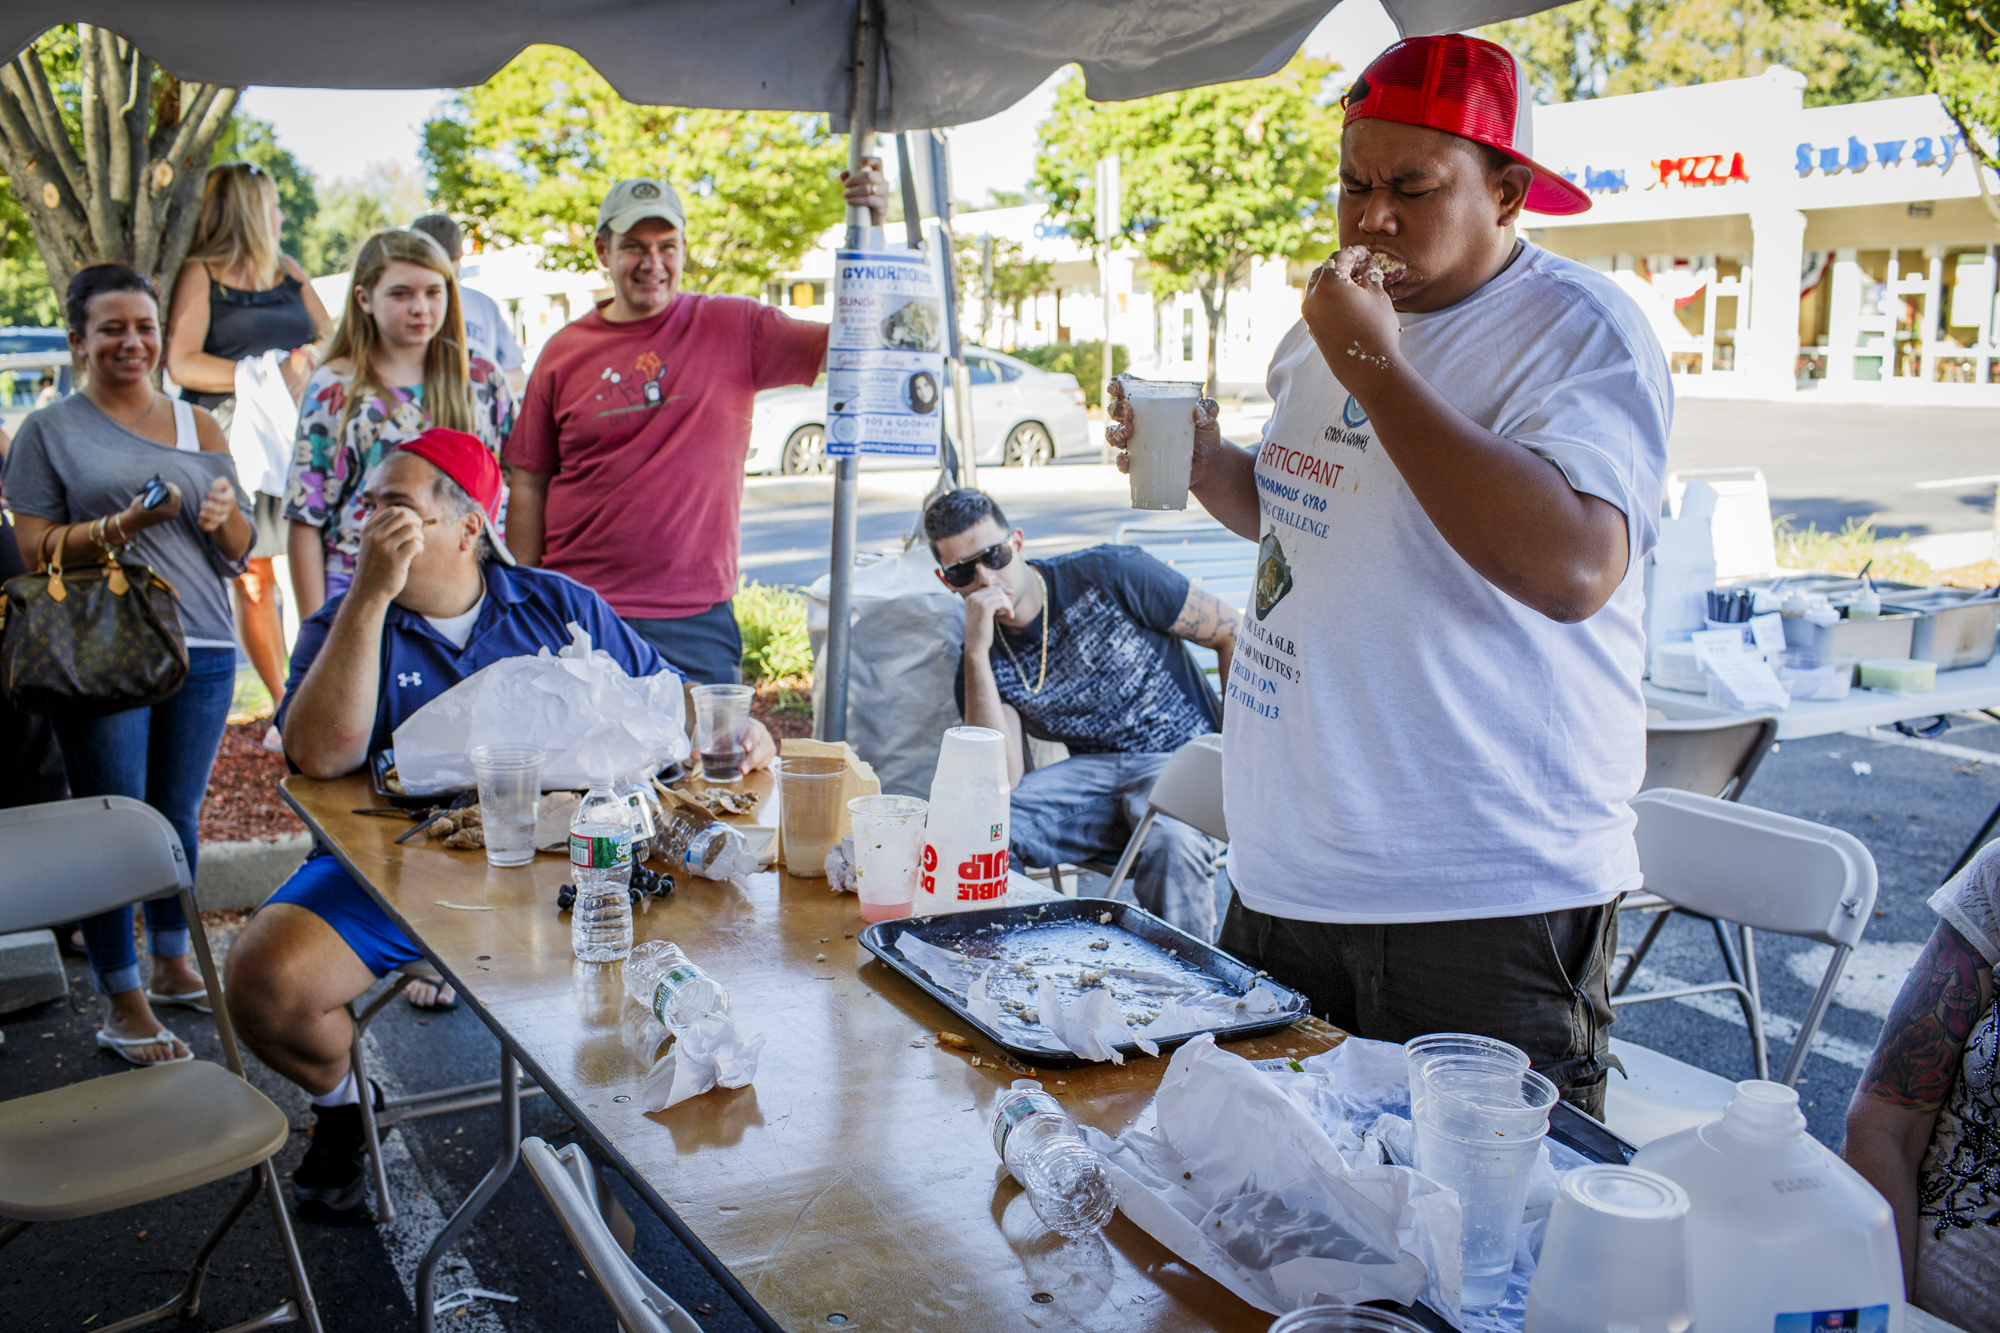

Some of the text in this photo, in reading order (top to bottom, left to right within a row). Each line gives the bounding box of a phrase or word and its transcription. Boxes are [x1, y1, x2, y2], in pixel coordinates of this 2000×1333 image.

[1795, 134, 1962, 178] Subway
[842, 265, 932, 284] GYNORMOUS
[1324, 425, 1345, 444] GYROS
[1260, 440, 1344, 489] ARTICIPANT
[1302, 493, 1328, 513] GYRO
[1271, 505, 1330, 539] CHALLENGE
[1253, 622, 1267, 642] EAT
[1265, 632, 1274, 647] A
[1275, 635, 1296, 658] 6LB.
[1252, 647, 1293, 681] MINUTES
[1258, 678, 1278, 695] ON
[957, 846, 1009, 880] ULP
[957, 875, 1008, 901] OUBLE
